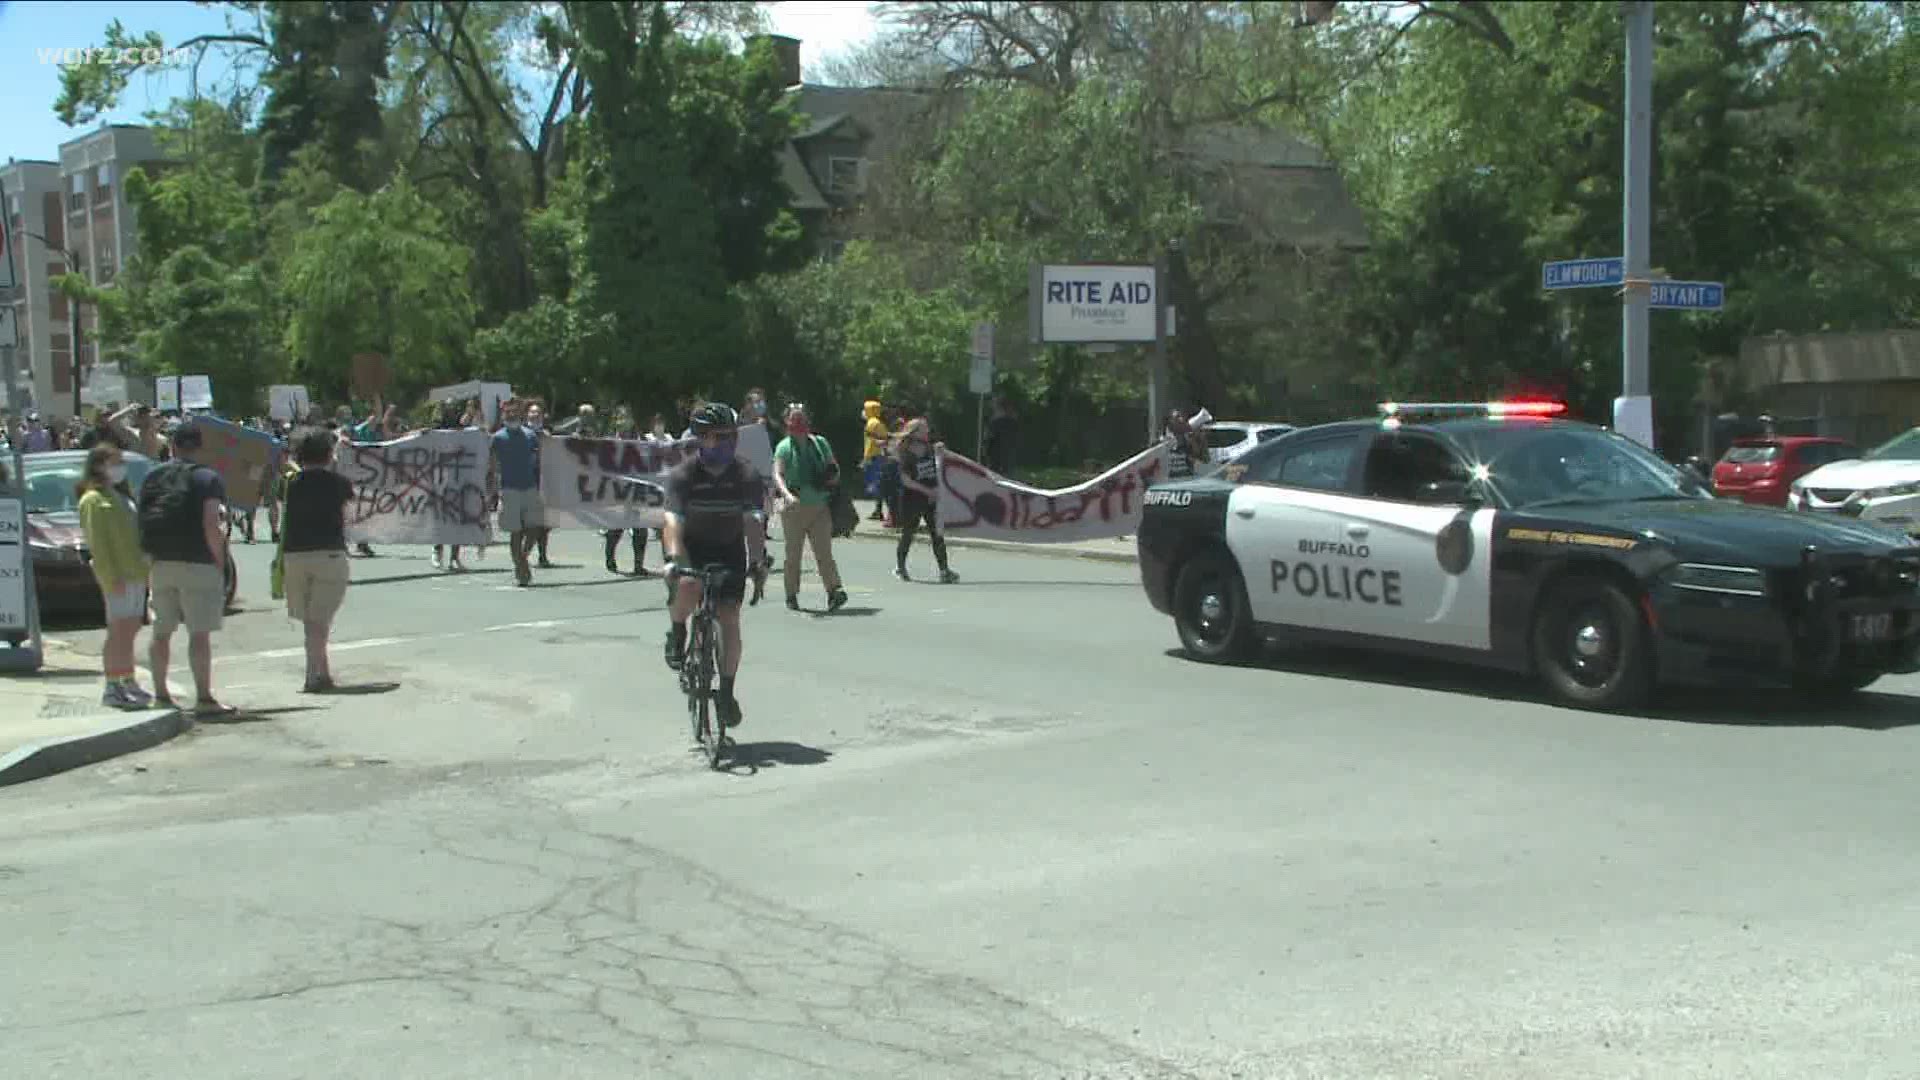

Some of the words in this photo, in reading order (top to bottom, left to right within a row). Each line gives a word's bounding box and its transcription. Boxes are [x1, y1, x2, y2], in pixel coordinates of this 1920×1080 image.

[1546, 263, 1608, 285] ELMWOOD
[1047, 280, 1102, 304] RITE
[1108, 281, 1151, 304] AID
[1650, 287, 1705, 305] BRYANT
[355, 447, 477, 484] SHERIFF
[353, 483, 485, 526] HOWARD
[1144, 491, 1192, 506] BUFFALO
[1299, 539, 1370, 558] BUFFALO
[1270, 559, 1404, 607] POLICE
